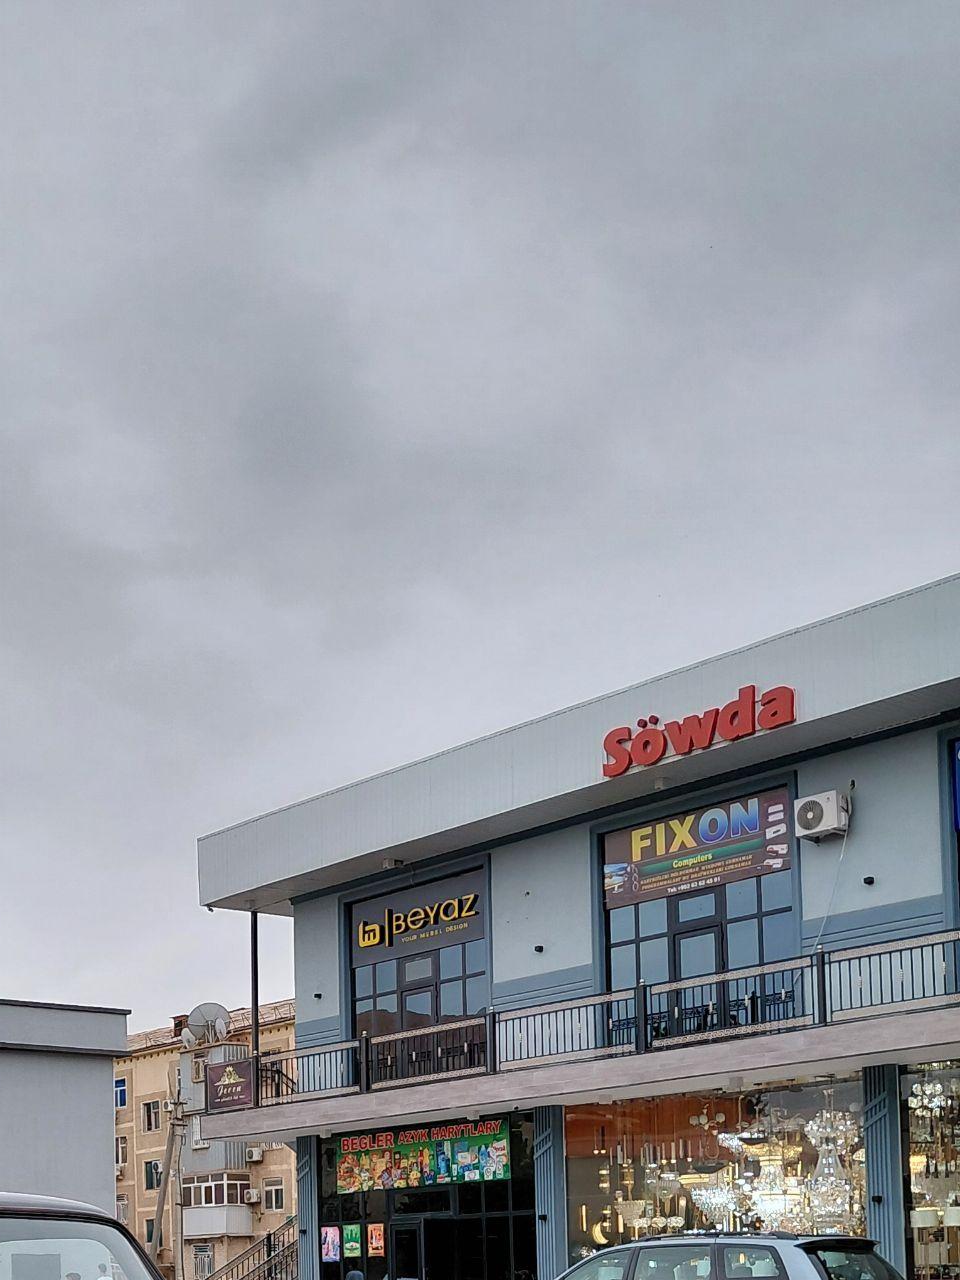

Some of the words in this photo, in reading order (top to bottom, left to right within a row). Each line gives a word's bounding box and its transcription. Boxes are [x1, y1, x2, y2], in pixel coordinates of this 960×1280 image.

[603, 684, 796, 778] Söwda
[631, 797, 760, 862] FIXON
[672, 853, 713, 869] Computers
[445, 922, 468, 933] DESIGN
[341, 1132, 394, 1153] BEGLER
[398, 1128, 429, 1145] AZYK
[431, 1119, 502, 1141] HARYTLARY
